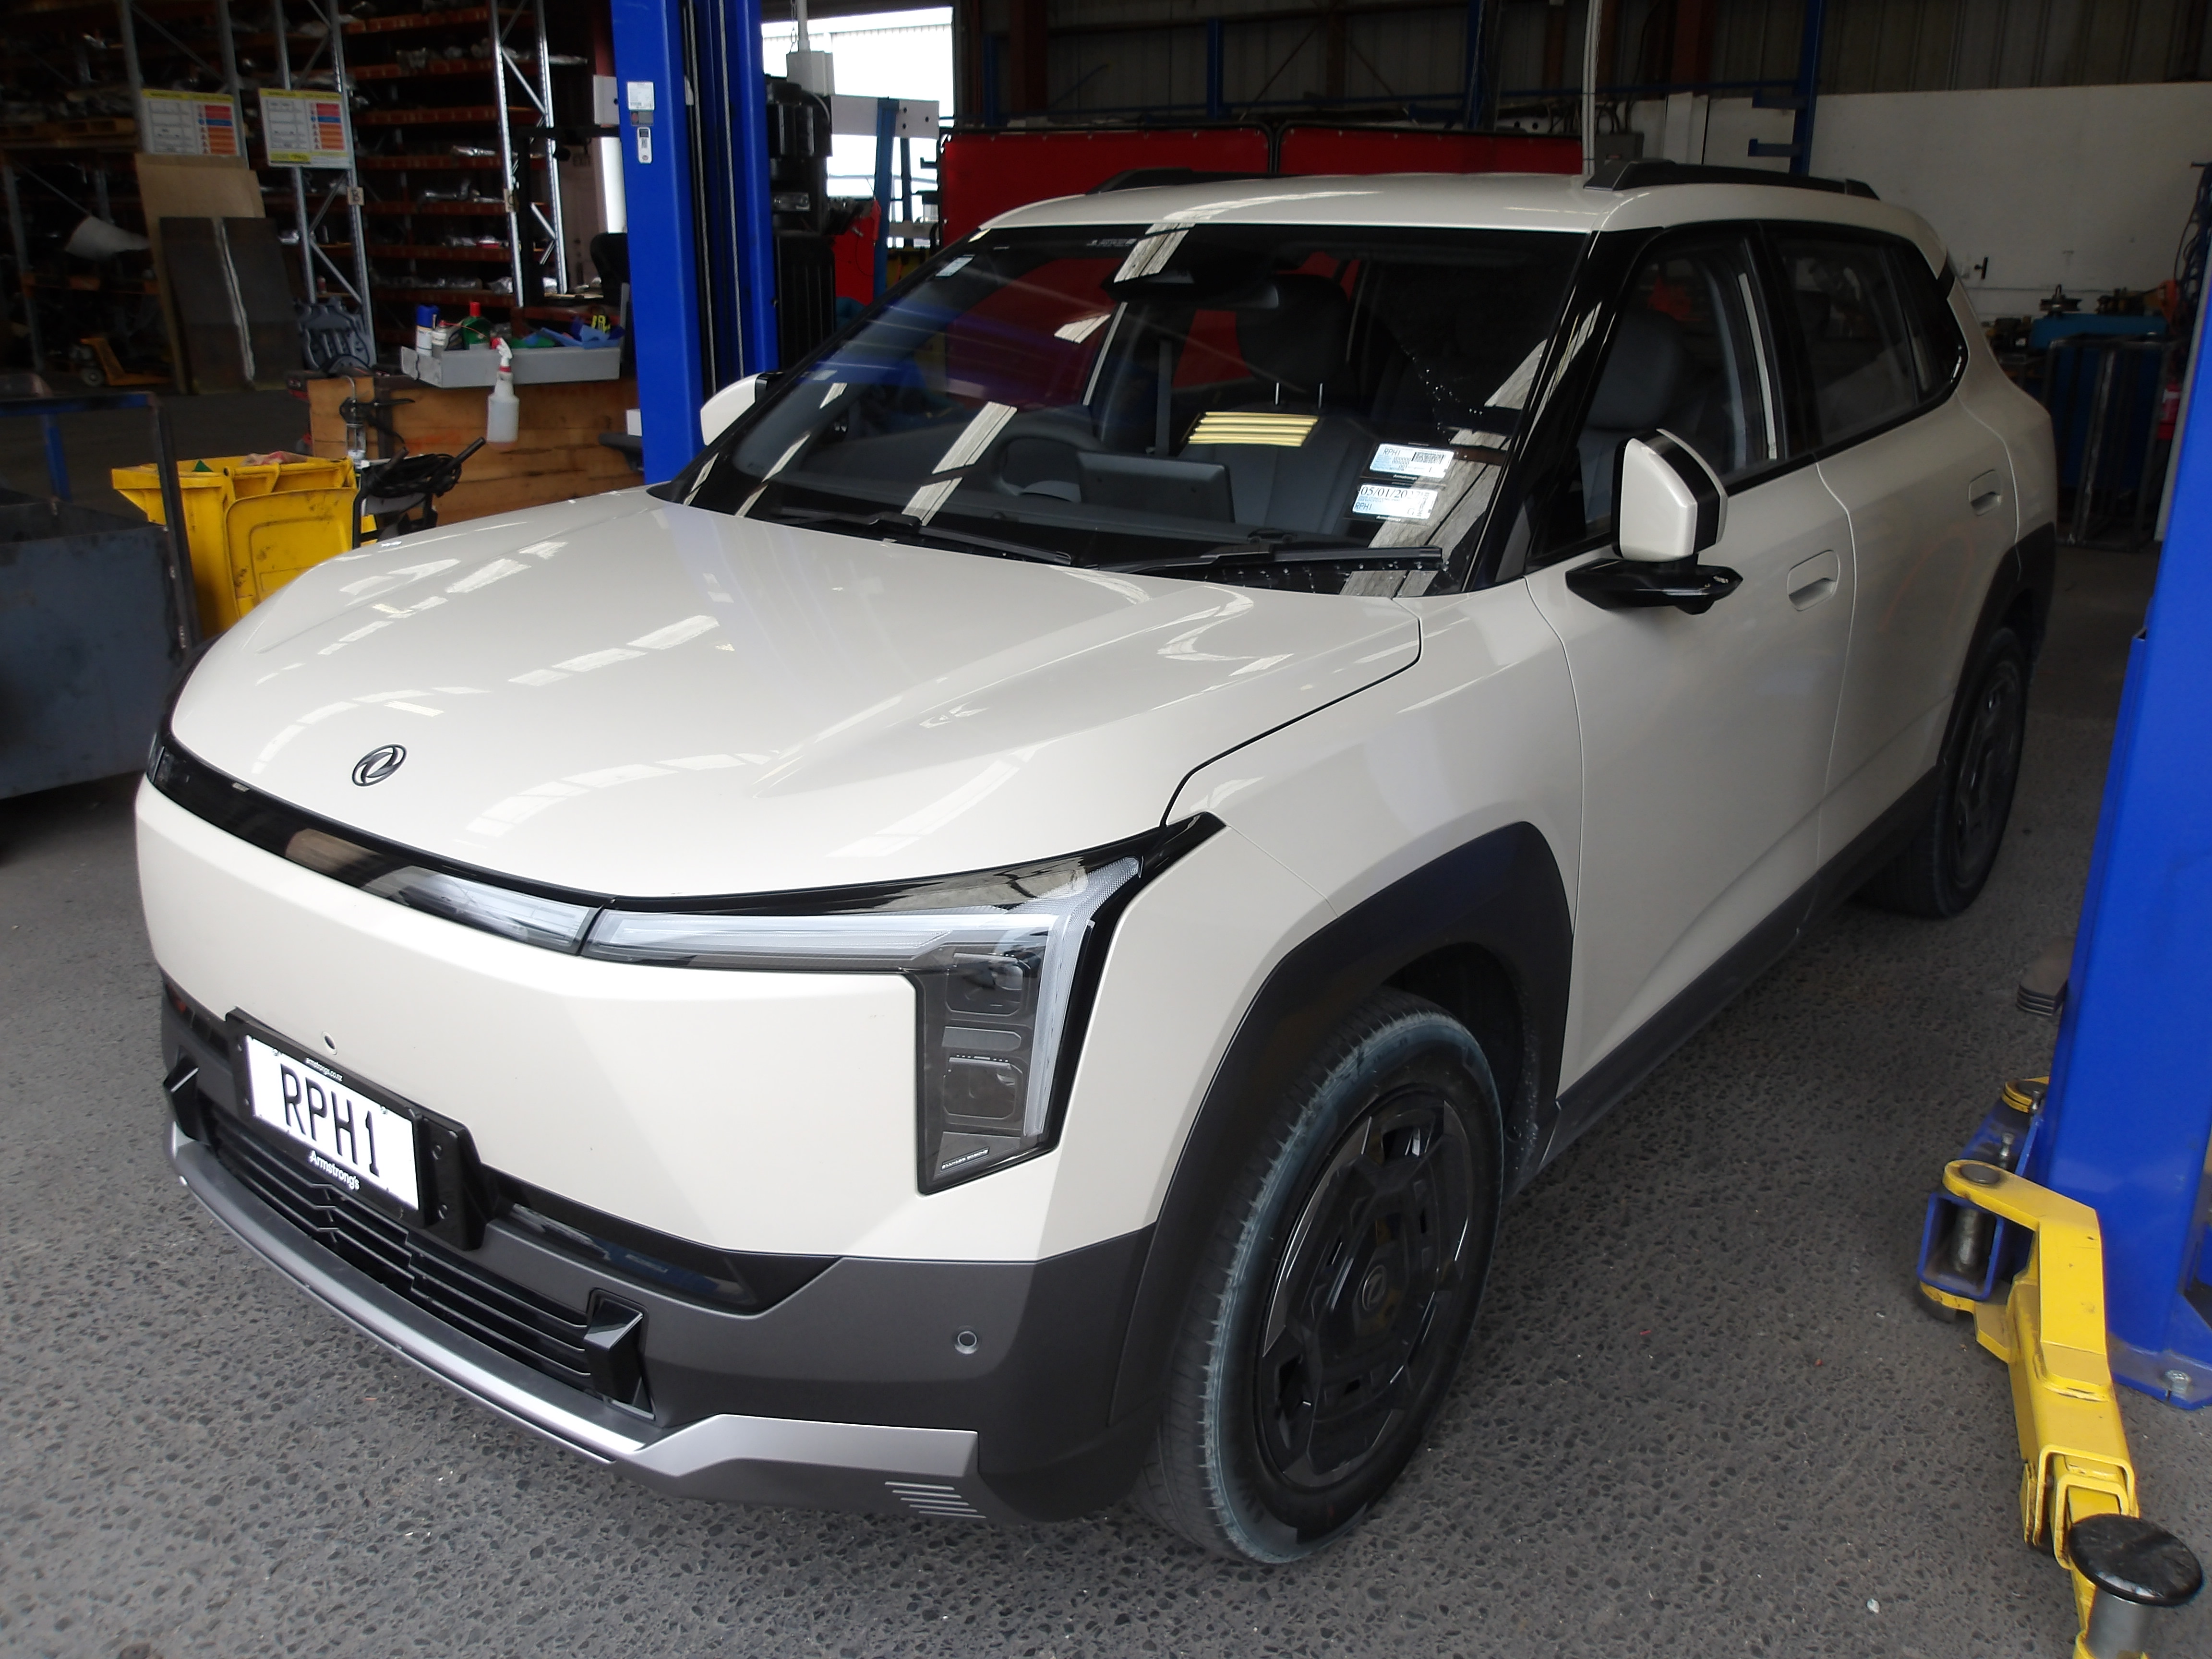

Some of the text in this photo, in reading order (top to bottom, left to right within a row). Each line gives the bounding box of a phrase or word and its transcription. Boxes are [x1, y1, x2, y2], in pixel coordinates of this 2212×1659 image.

[305, 1057, 343, 1082] armstrongs.co.nz
[280, 1063, 380, 1178] RPH1
[310, 1150, 360, 1190] Armstrong's
